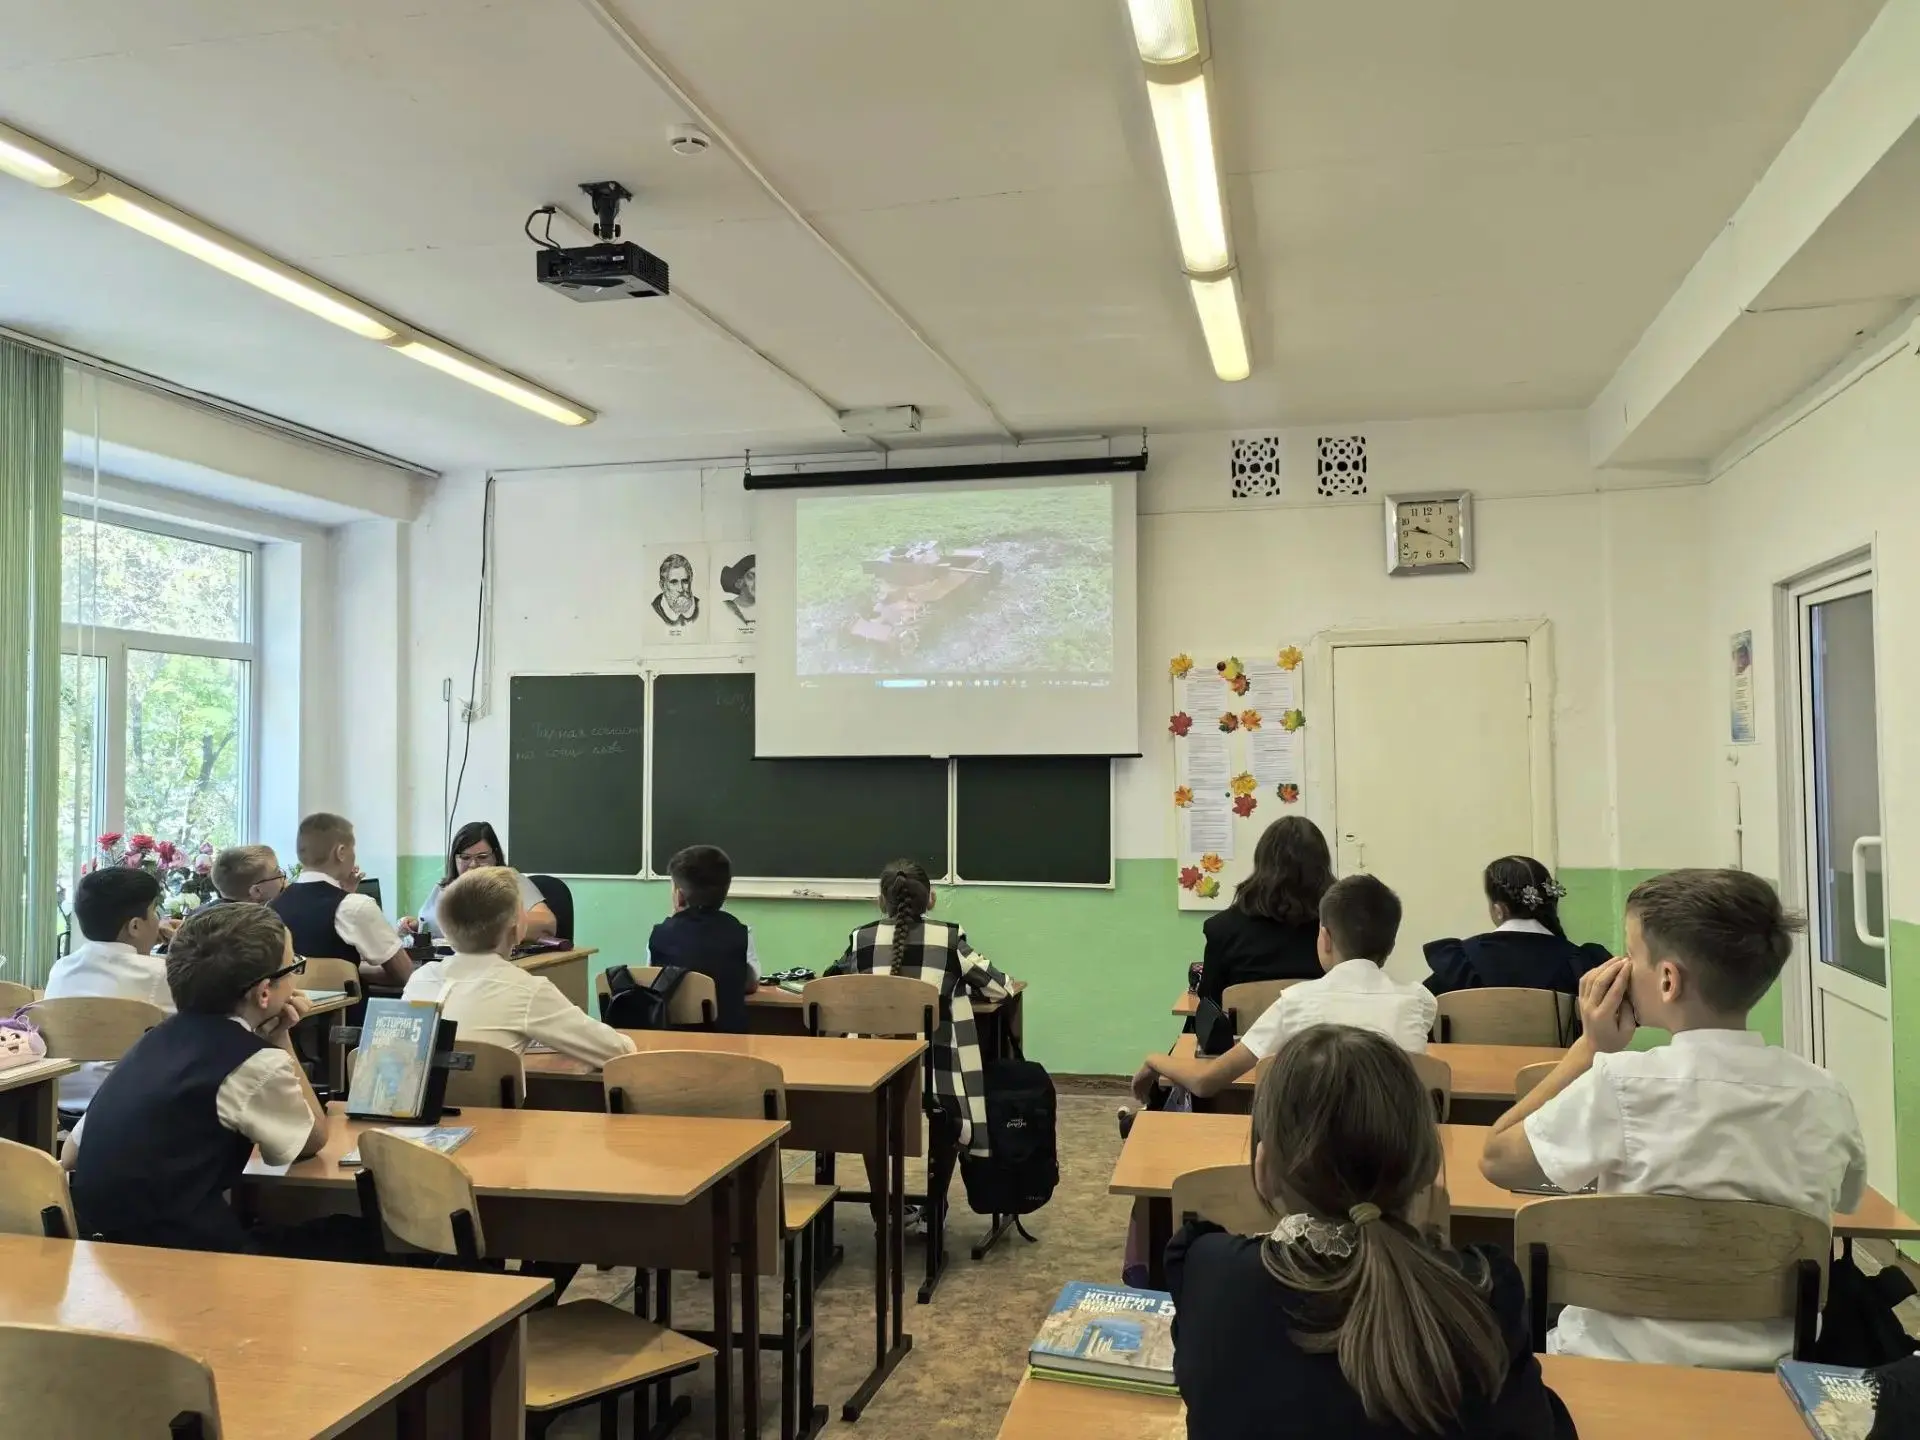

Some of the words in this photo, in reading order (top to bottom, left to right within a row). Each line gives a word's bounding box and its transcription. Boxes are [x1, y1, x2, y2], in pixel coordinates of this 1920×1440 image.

[1411, 508, 1418, 517] 11
[1423, 507, 1433, 516] 12
[1401, 518, 1410, 526] 10
[1447, 515, 1453, 523] 2
[1447, 528, 1453, 536] 3
[1448, 540, 1454, 548] 4
[1413, 551, 1419, 559] 7
[1425, 551, 1432, 559] 6
[1439, 550, 1445, 558] 5
[411, 1018, 424, 1043] 5
[1084, 1291, 1156, 1307] ИСТОРИЯ
[1158, 1300, 1177, 1316] 5
